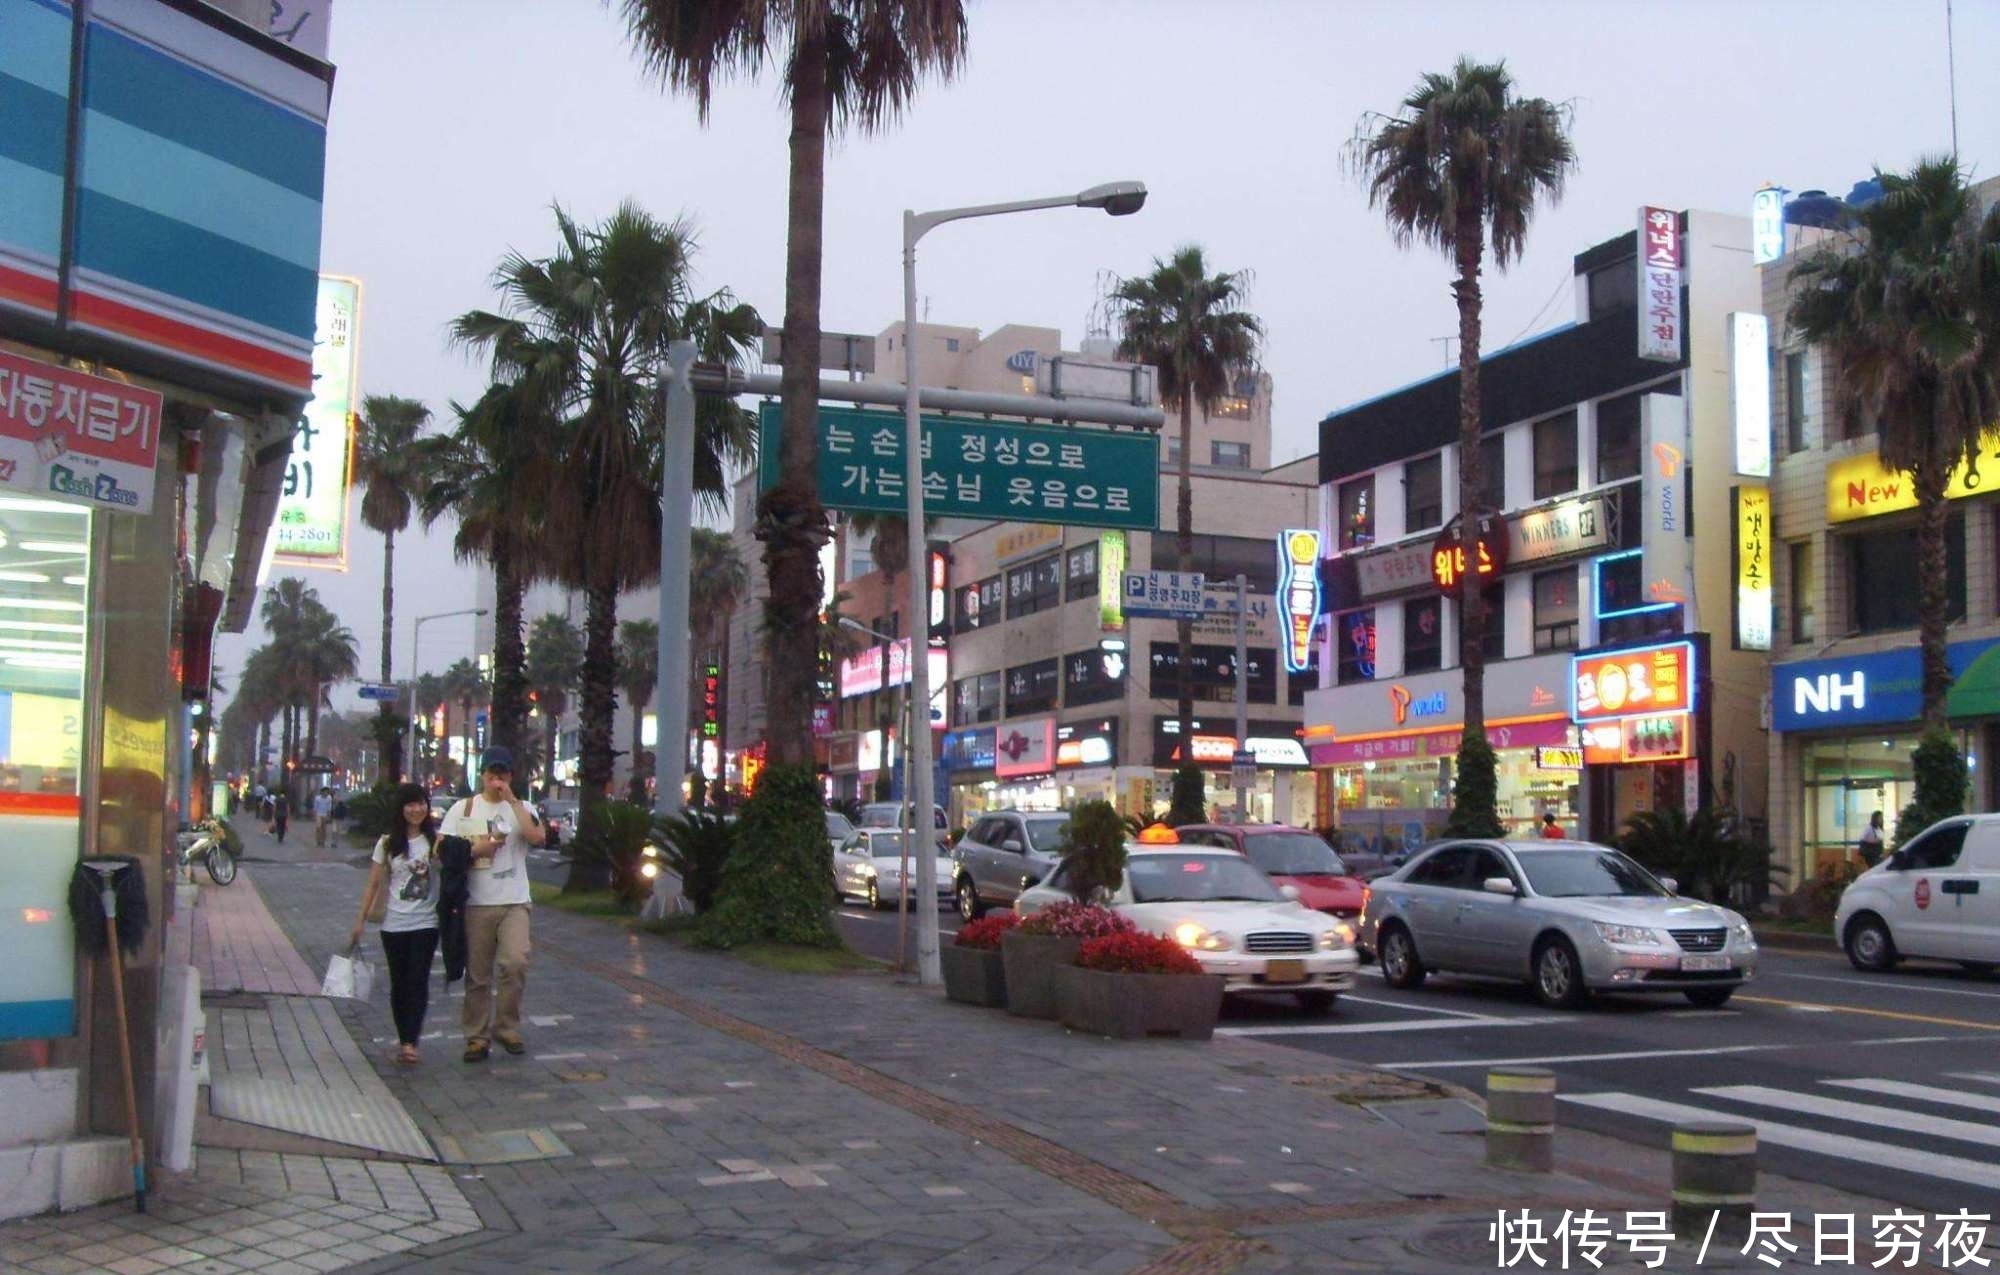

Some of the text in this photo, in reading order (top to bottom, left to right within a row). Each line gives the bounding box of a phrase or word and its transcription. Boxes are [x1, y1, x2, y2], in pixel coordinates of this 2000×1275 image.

[0, 367, 150, 450] 자동지급기
[960, 434, 1086, 470] 정성으로
[842, 464, 1132, 512] 가는 손님 웃음으로
[1662, 486, 1676, 532] world
[1848, 479, 1899, 508] New
[1412, 692, 1446, 717] world
[1794, 670, 1865, 714] NH
